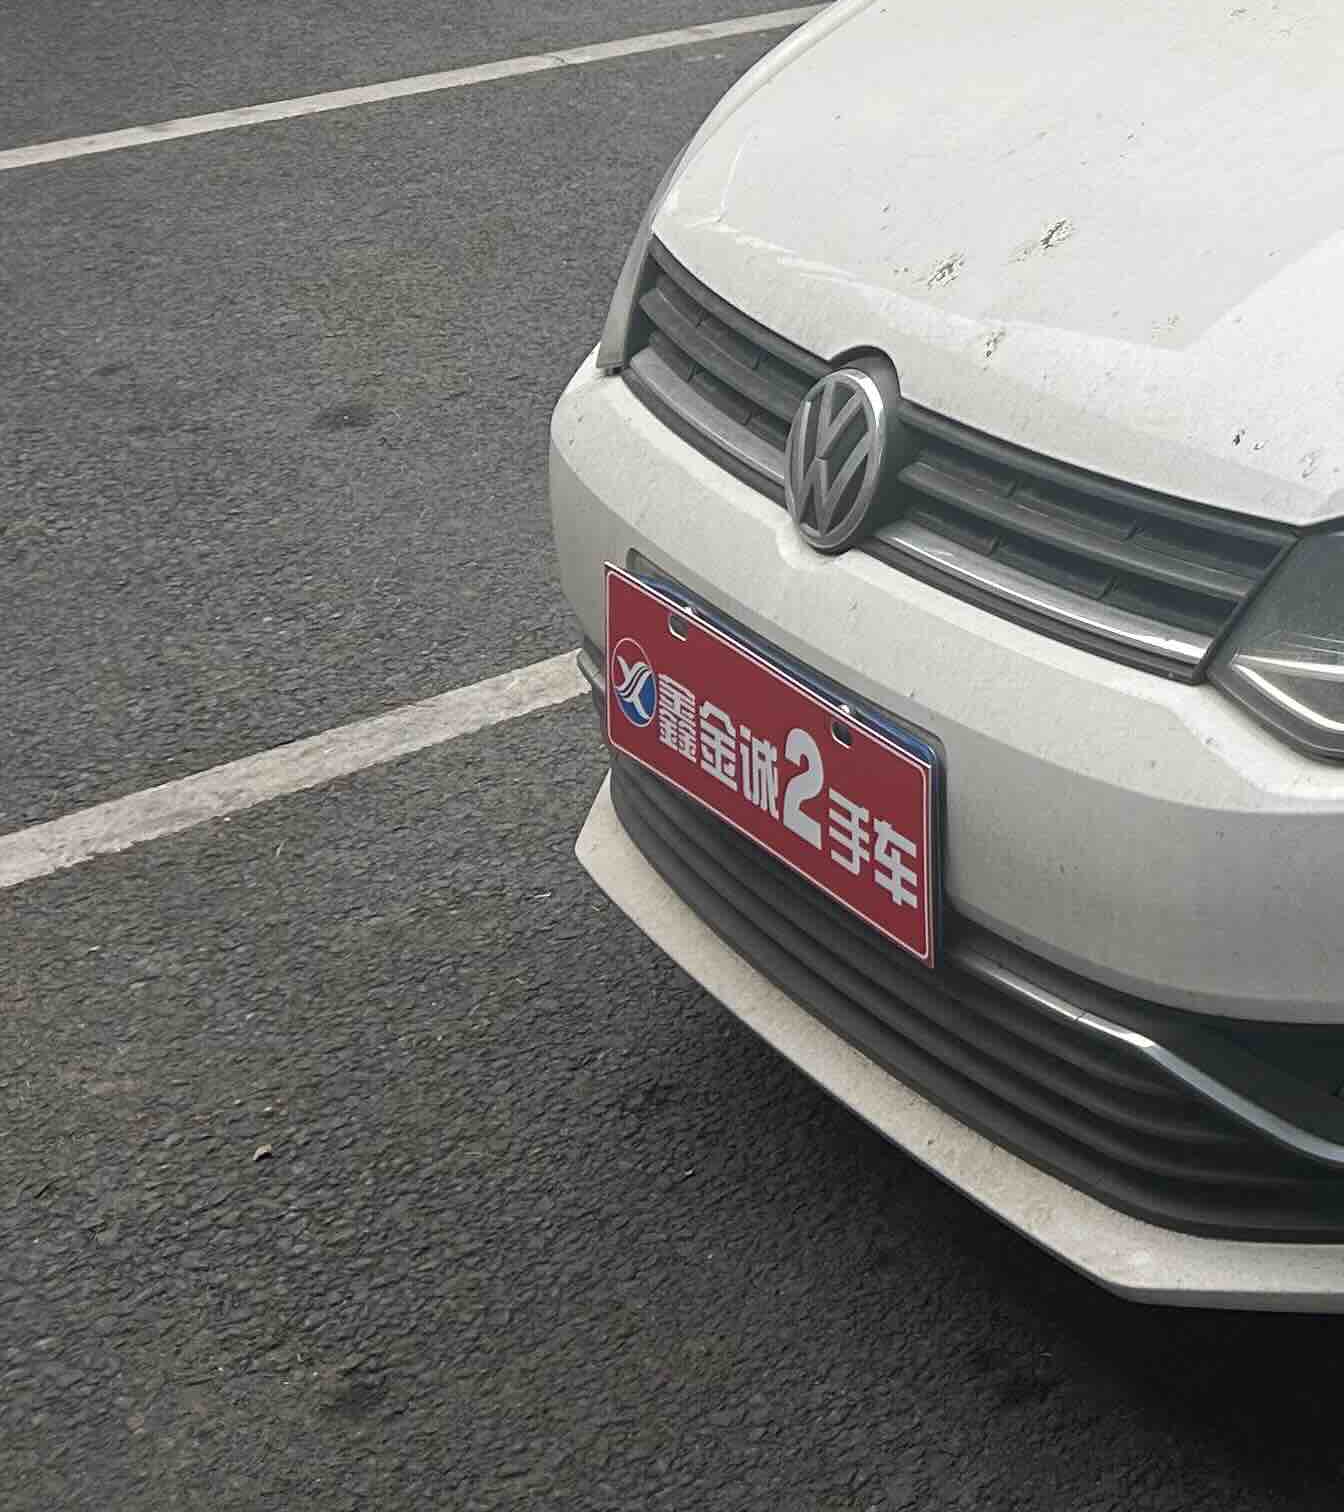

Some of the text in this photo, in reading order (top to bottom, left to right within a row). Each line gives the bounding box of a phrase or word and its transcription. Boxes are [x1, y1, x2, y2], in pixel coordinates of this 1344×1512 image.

[657, 673, 918, 909] 鑫金诚2手车
